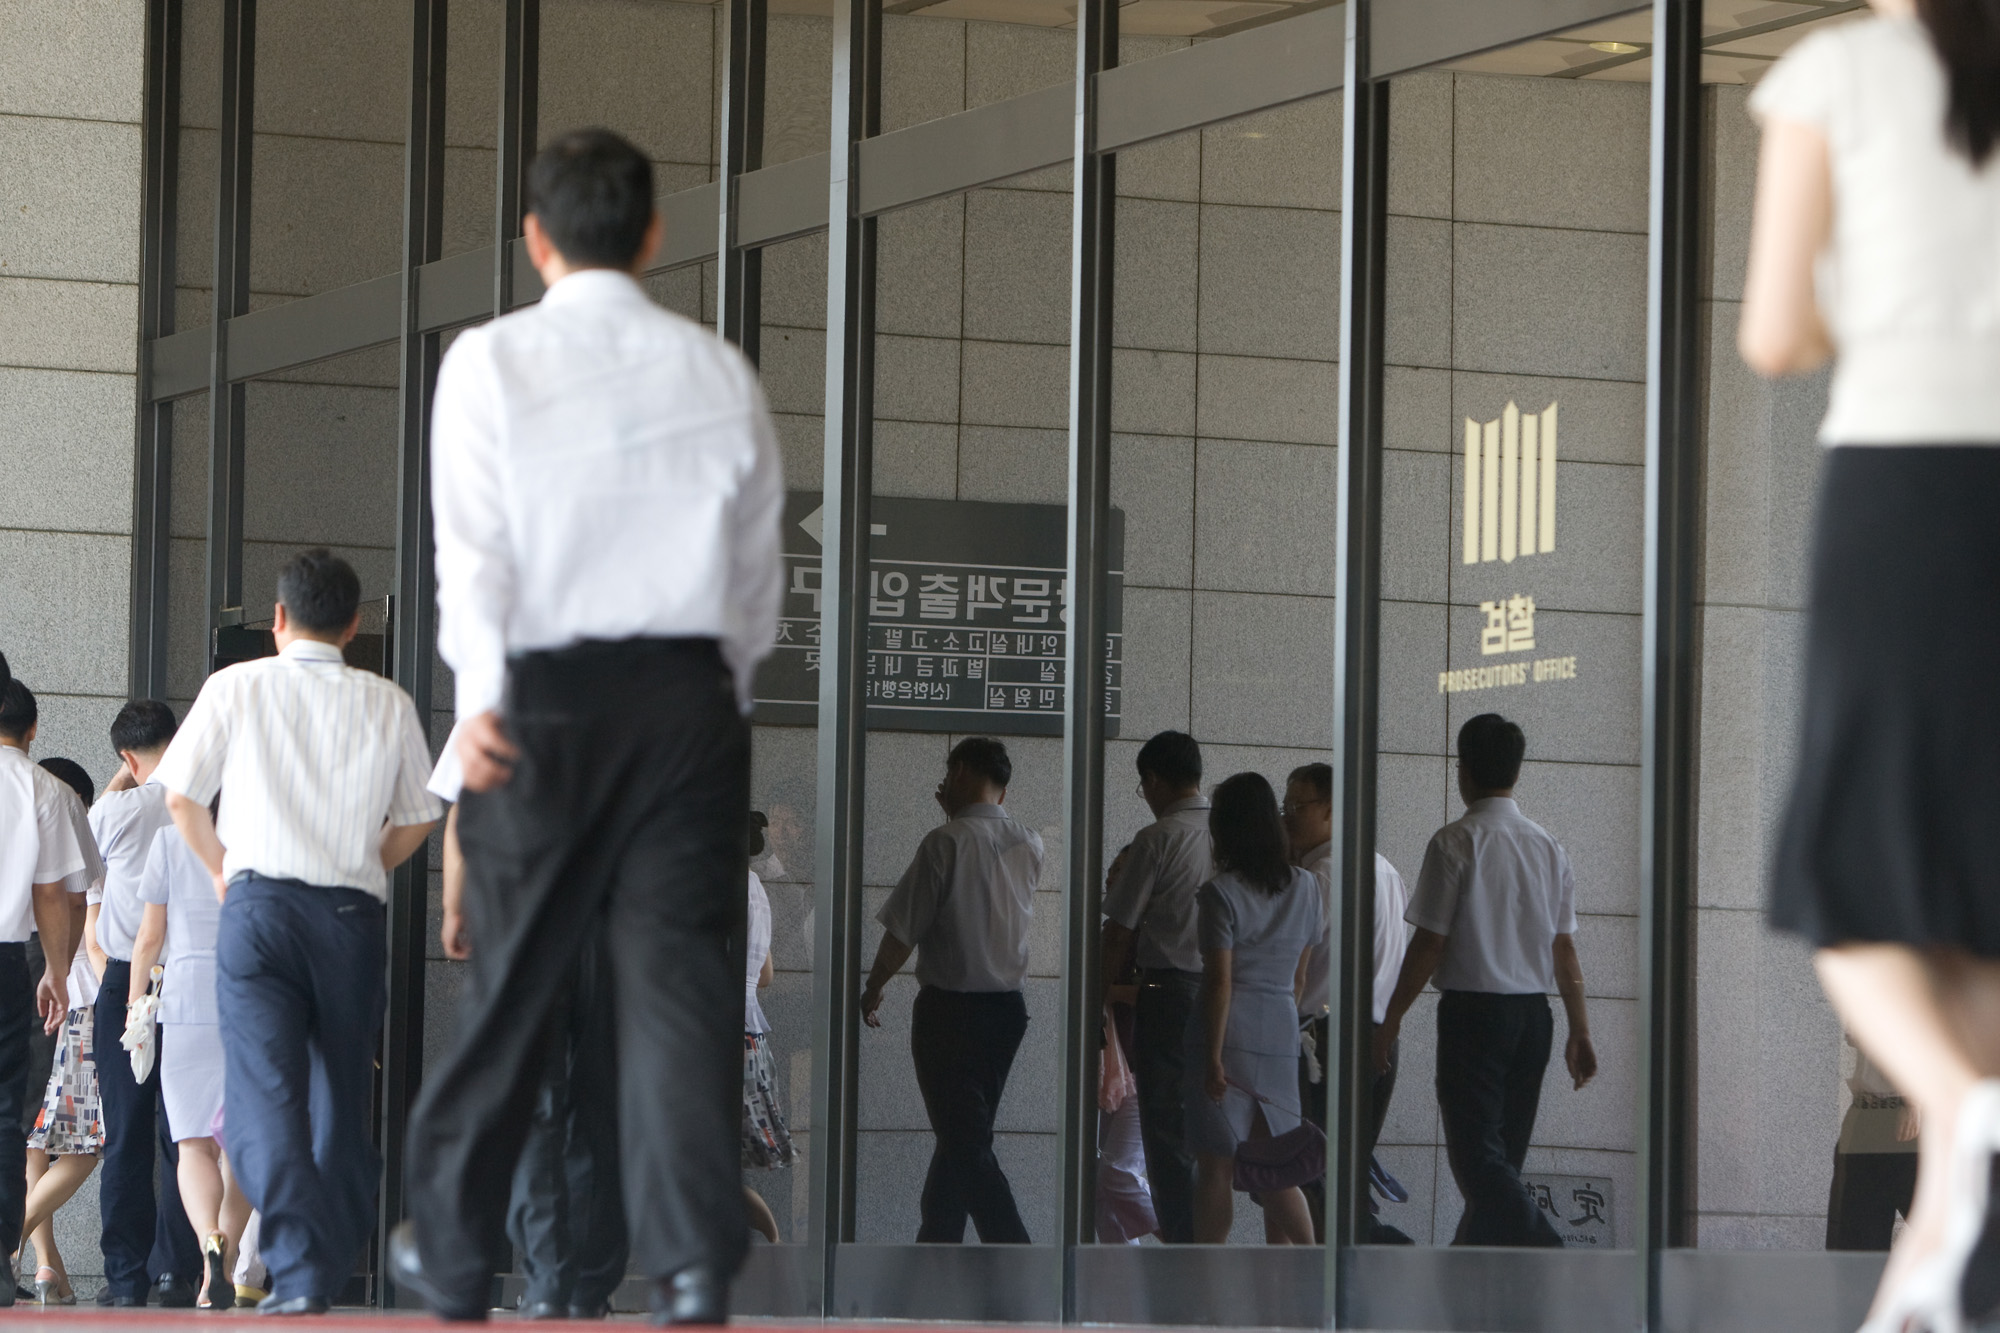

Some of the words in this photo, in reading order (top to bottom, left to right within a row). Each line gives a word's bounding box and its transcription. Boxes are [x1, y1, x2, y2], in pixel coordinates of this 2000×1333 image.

[1480, 593, 1536, 656] 검찰
[1438, 662, 1530, 694] PROSECUTORS'
[1533, 656, 1577, 683] OFFICE
